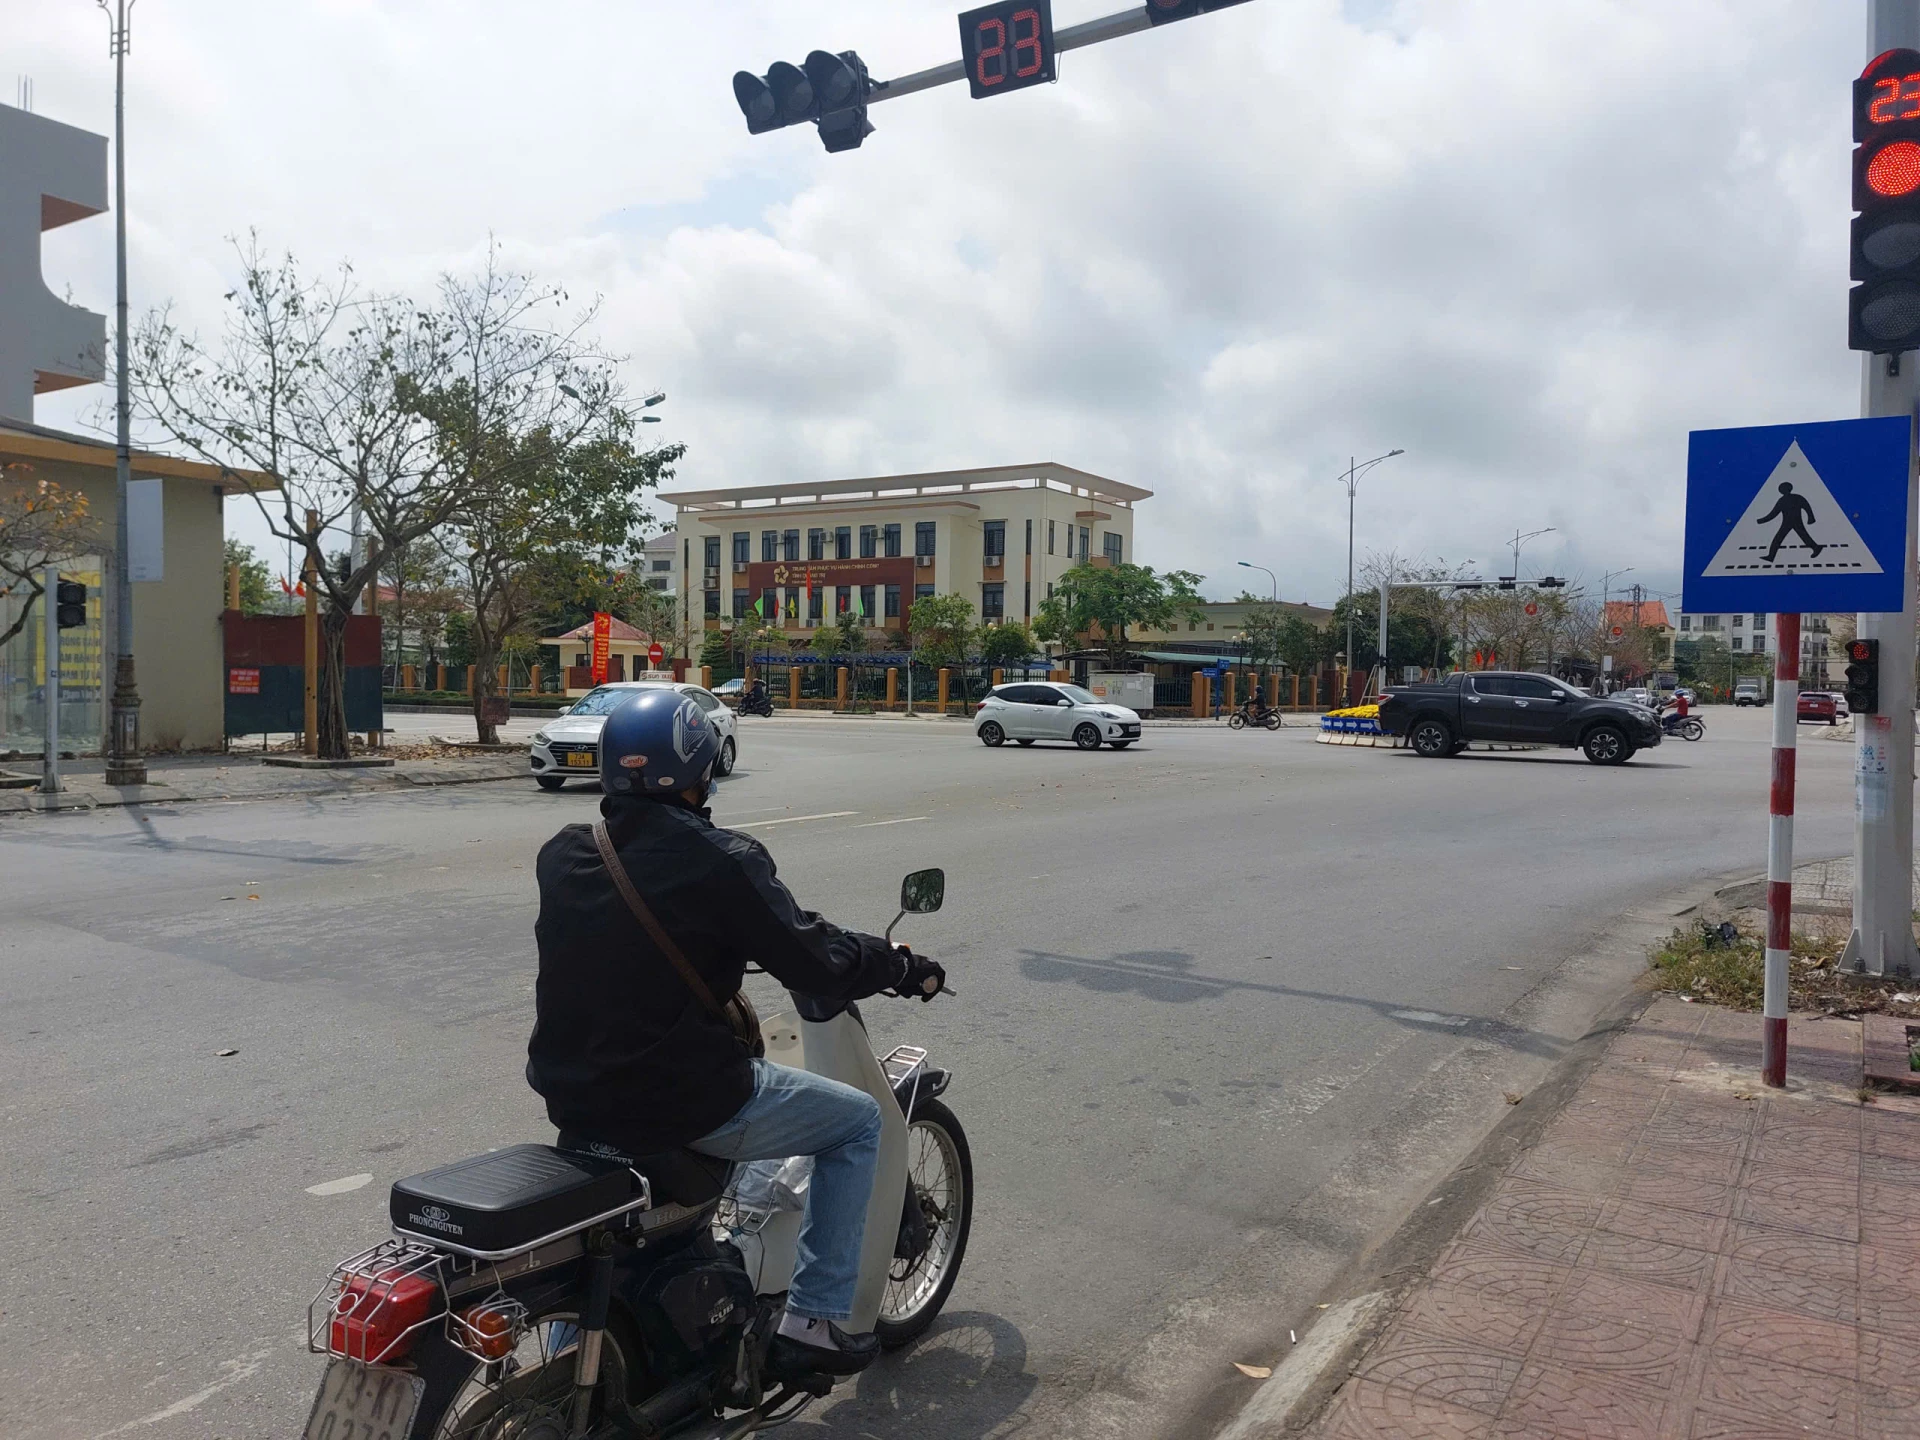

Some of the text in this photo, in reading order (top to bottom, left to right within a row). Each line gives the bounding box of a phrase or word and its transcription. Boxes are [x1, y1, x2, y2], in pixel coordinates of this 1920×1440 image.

[978, 8, 1042, 86] 23
[1869, 71, 1920, 123] 23
[408, 1213, 463, 1235] PHONGNGUYEN
[710, 1303, 734, 1325] CUB
